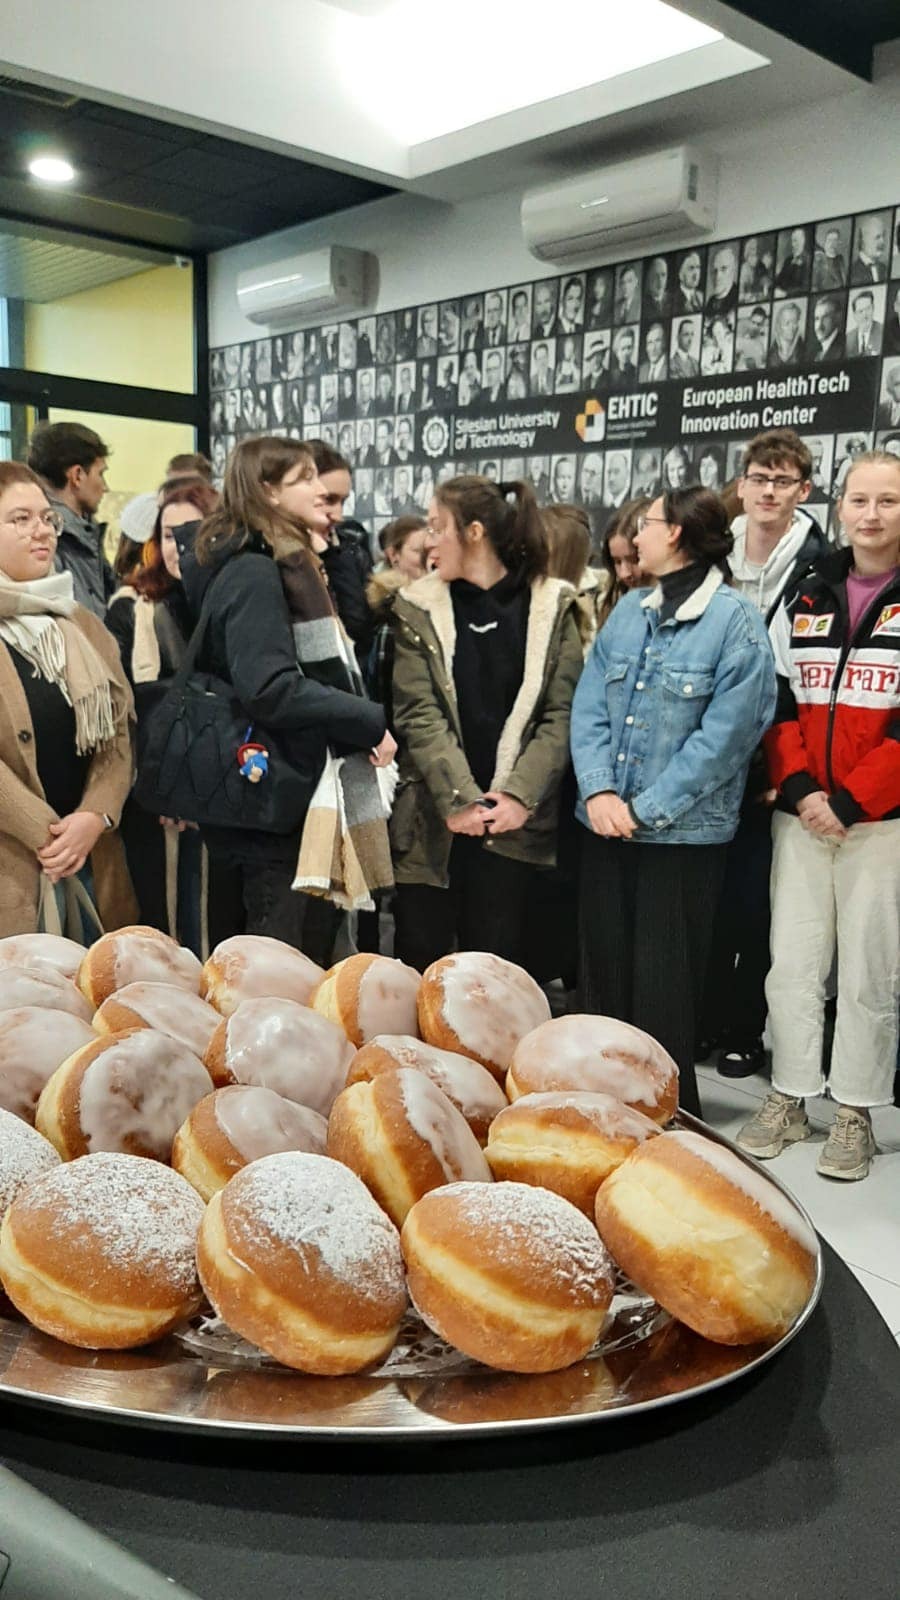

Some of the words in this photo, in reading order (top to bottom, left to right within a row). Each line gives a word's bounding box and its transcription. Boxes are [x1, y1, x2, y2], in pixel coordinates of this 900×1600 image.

[682, 385, 753, 409] European
[756, 370, 850, 400] HealthTech
[608, 392, 658, 420] EHTIC
[681, 410, 759, 434] Innovation
[762, 406, 817, 427] Center
[455, 418, 497, 435] Silesian
[499, 410, 560, 429] University
[455, 434, 467, 450] of
[468, 430, 536, 449] Technology
